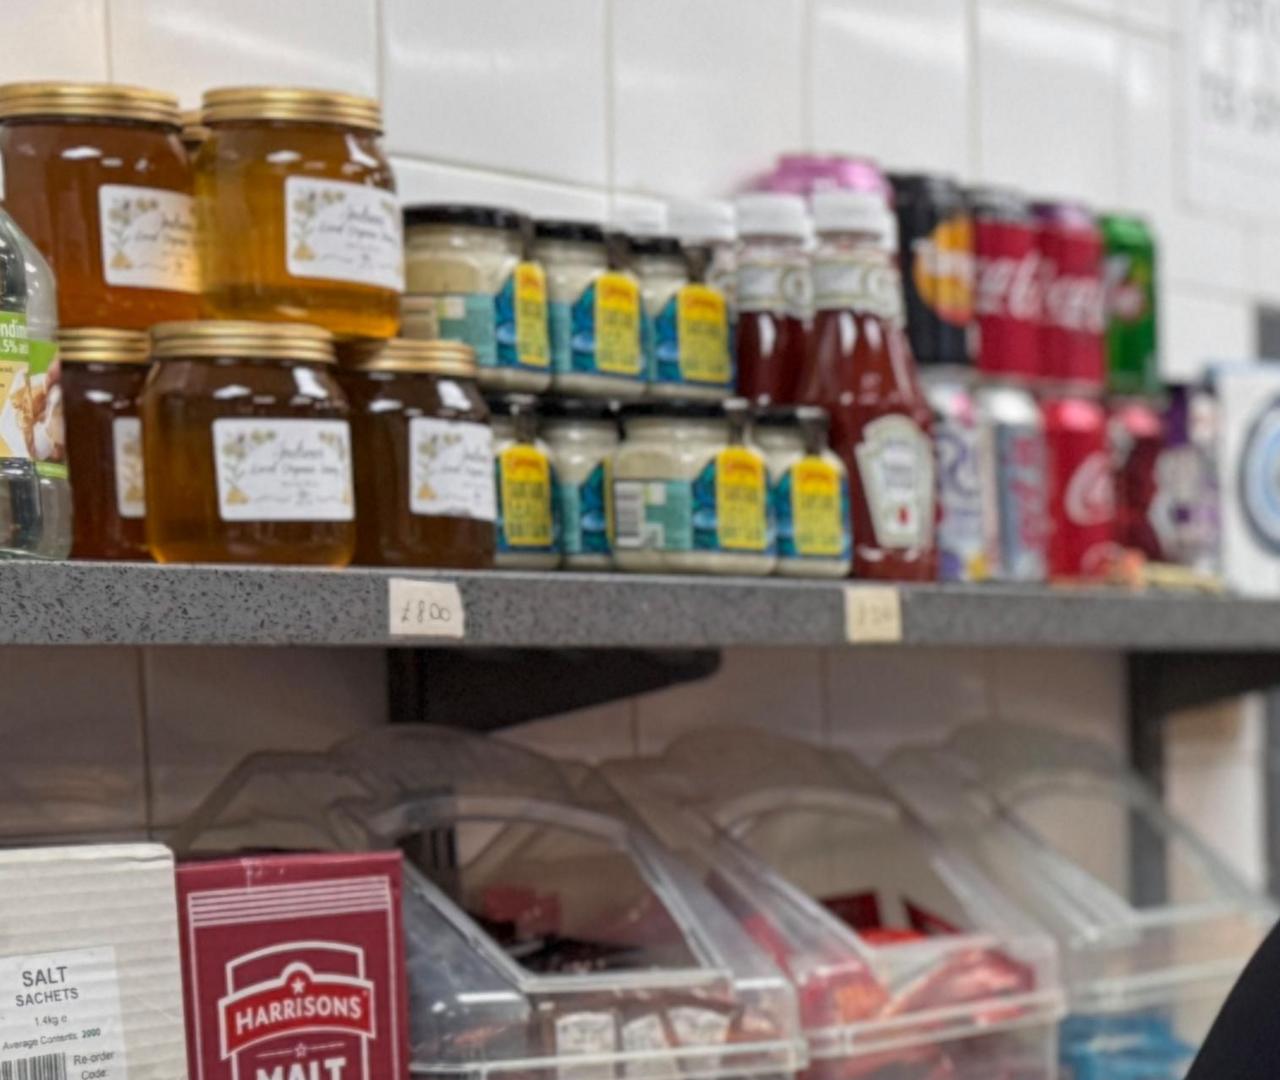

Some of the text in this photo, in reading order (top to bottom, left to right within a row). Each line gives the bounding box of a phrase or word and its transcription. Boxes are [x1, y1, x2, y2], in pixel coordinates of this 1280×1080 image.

[22, 966, 67, 988] SALT
[15, 988, 79, 1007] SACHETS
[236, 995, 362, 1036] HARRISONS
[73, 1051, 114, 1065] Re-order
